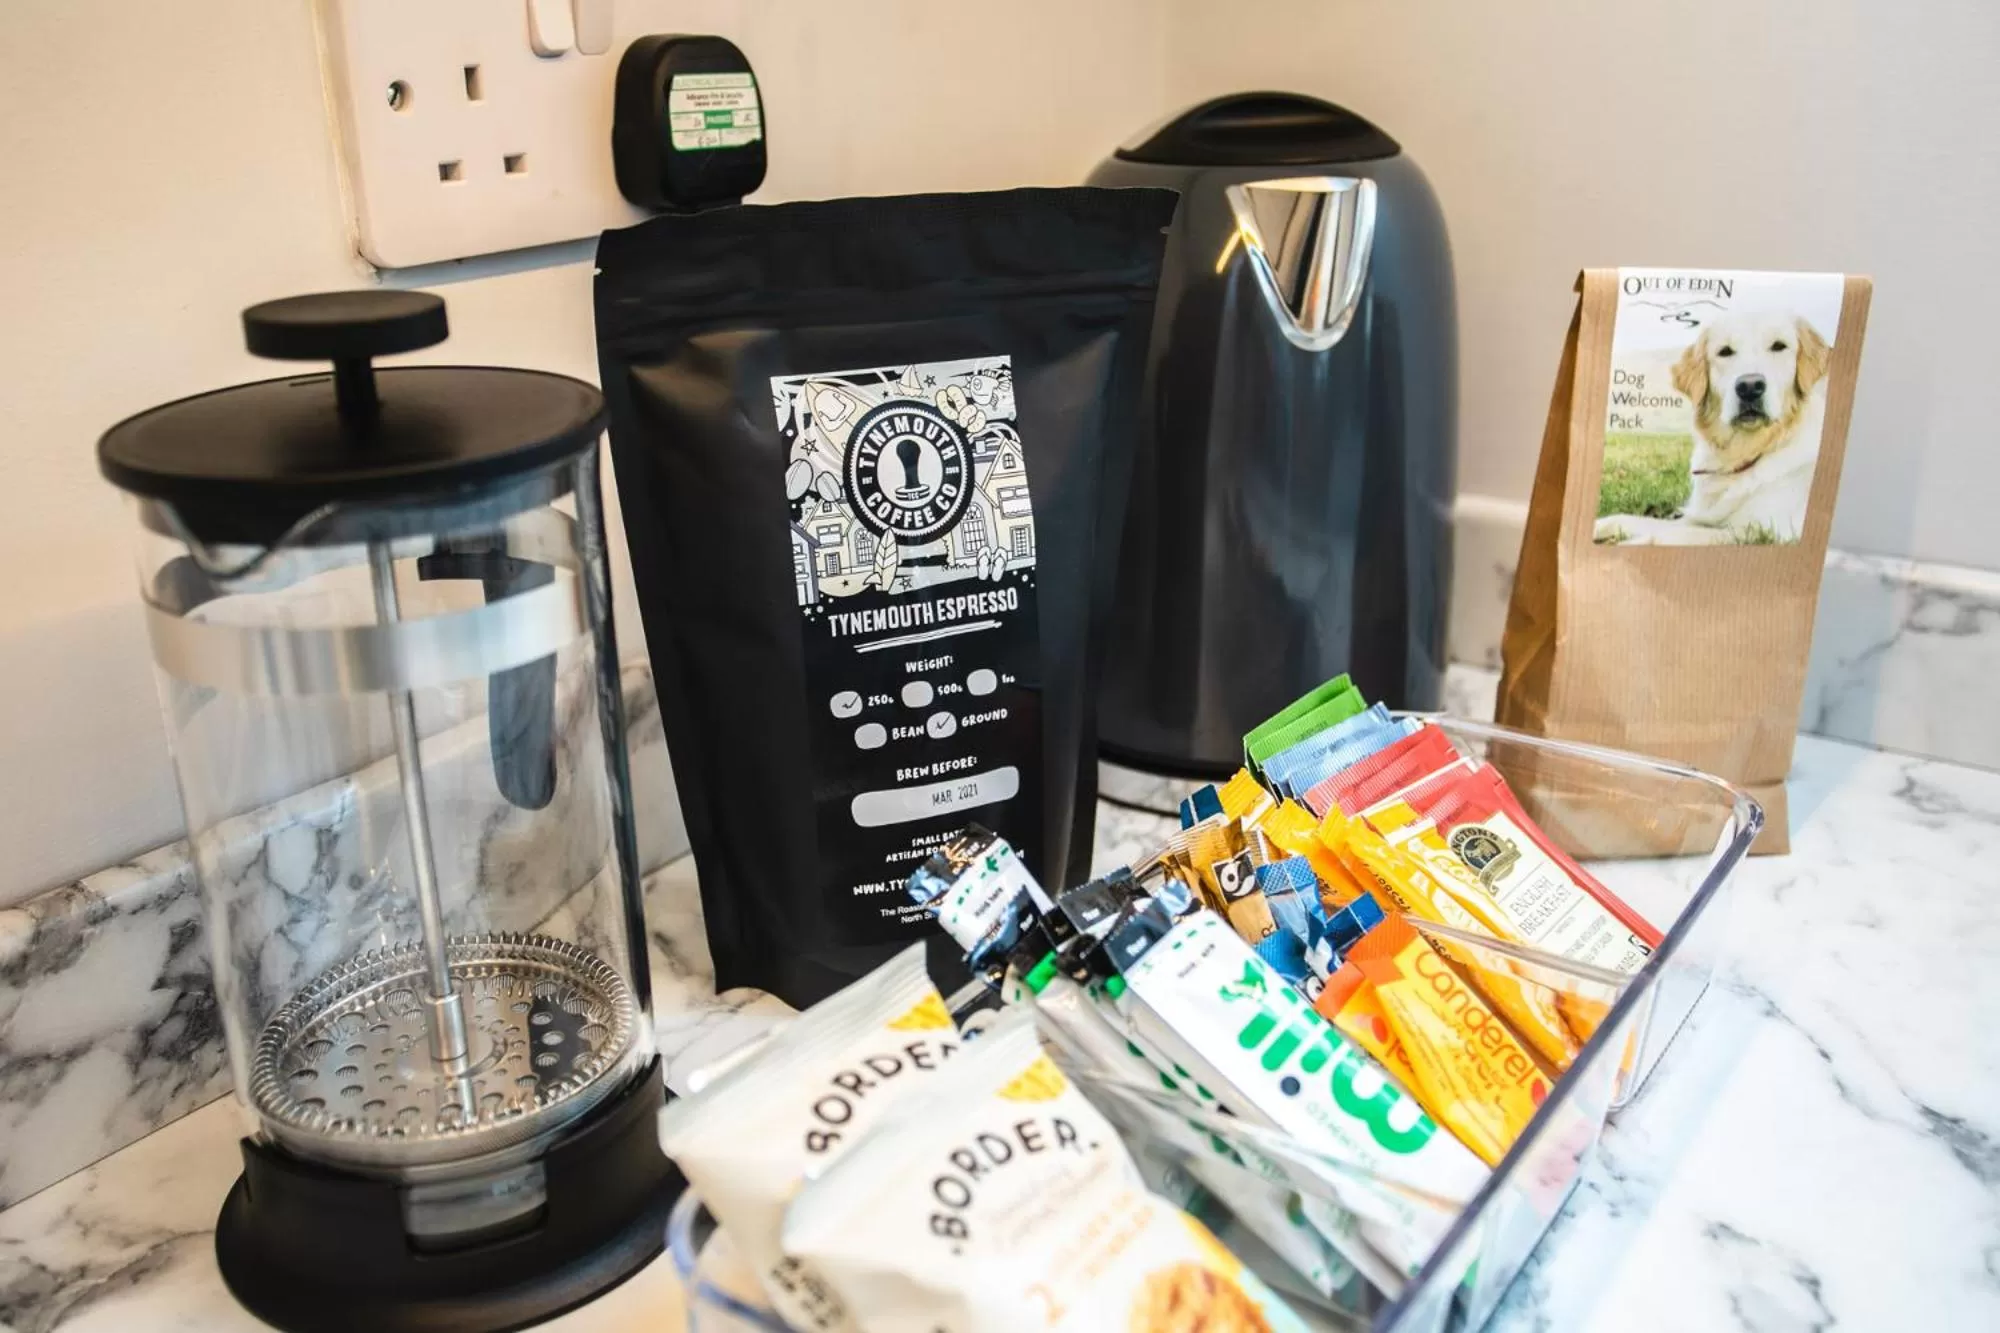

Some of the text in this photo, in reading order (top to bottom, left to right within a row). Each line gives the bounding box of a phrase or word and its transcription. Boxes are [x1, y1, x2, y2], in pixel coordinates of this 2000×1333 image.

[1613, 370, 1646, 389] Dog
[1612, 391, 1684, 408] Welcome
[1609, 413, 1644, 429] Pack
[859, 415, 957, 468] TYNEMOUTH
[866, 483, 957, 529] COFFEE CO
[828, 588, 1019, 638] TYNEMOUTH ESPRESSO
[905, 655, 953, 674] WEIGHT:
[892, 708, 1008, 740] BEAN GROUND
[896, 756, 978, 782] BREW BEFORE:
[932, 783, 979, 807] MAR 2021
[942, 828, 965, 842] BAT
[885, 848, 925, 863] ARTISAN
[1509, 876, 1556, 916] ENGLISH
[880, 908, 896, 918] The
[1518, 884, 1572, 937] BREAKFAST
[1414, 950, 1537, 1086] Canderel
